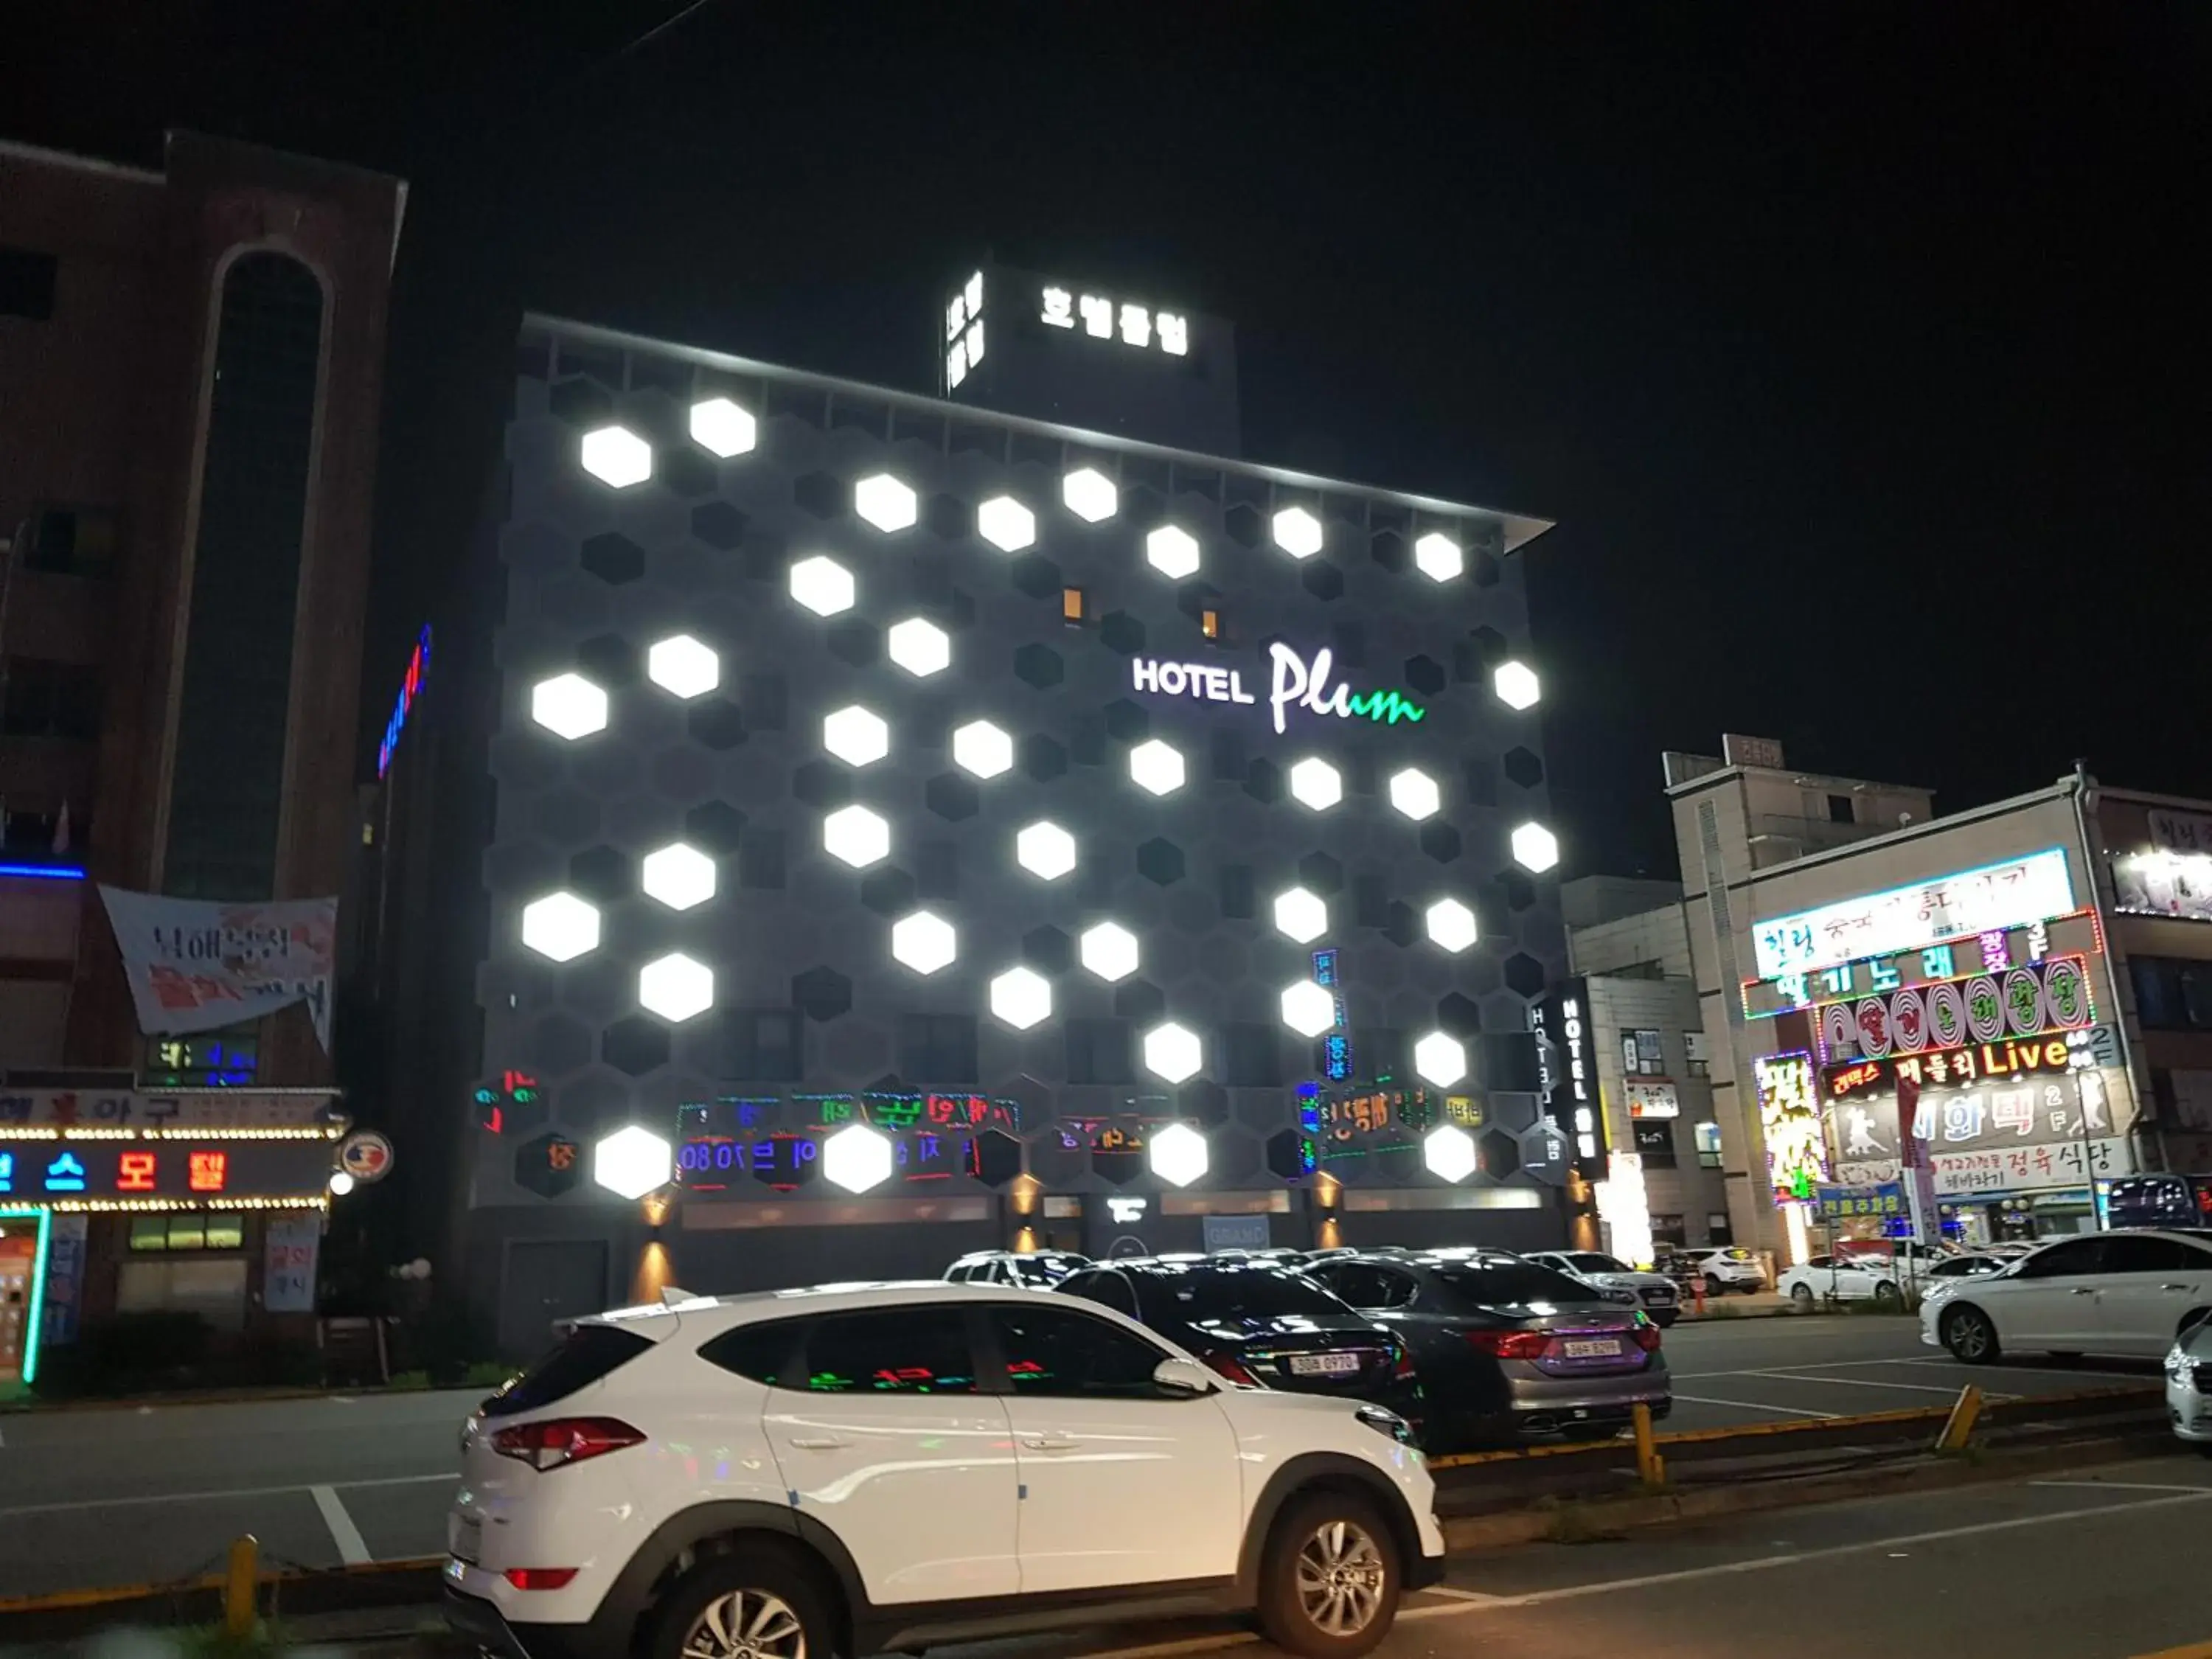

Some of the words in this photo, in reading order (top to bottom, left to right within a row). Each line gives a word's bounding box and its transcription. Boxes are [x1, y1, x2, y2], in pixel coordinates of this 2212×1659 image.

[1133, 658, 1255, 706] HOTEL
[1269, 641, 1425, 734] Plum
[1562, 999, 1587, 1099] HOTEL
[1983, 1037, 2068, 1077] Live
